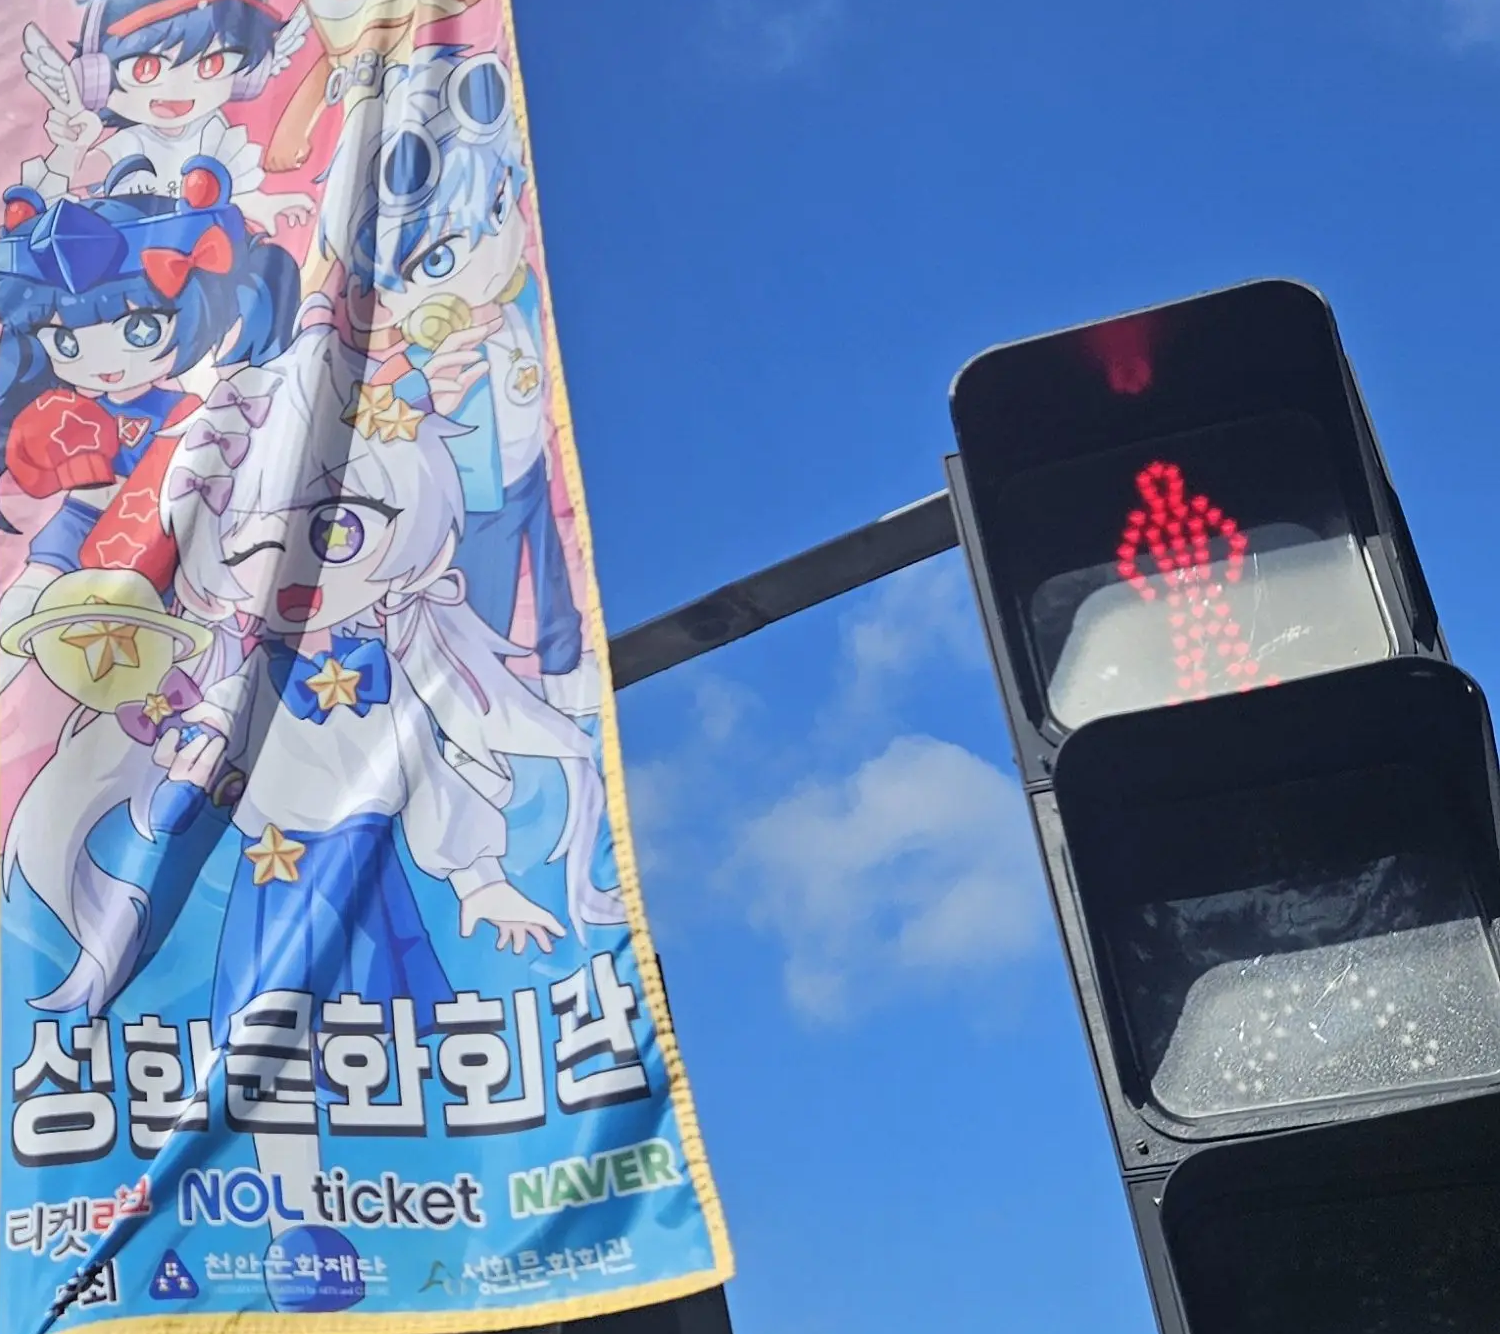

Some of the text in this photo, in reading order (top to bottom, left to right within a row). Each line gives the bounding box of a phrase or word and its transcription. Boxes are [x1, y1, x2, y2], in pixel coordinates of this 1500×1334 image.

[11, 951, 652, 1166] 성환문화회관
[180, 1171, 483, 1228] NOL ticket
[510, 1141, 680, 1218] NAVER
[204, 1245, 389, 1282] 천안문화재단
